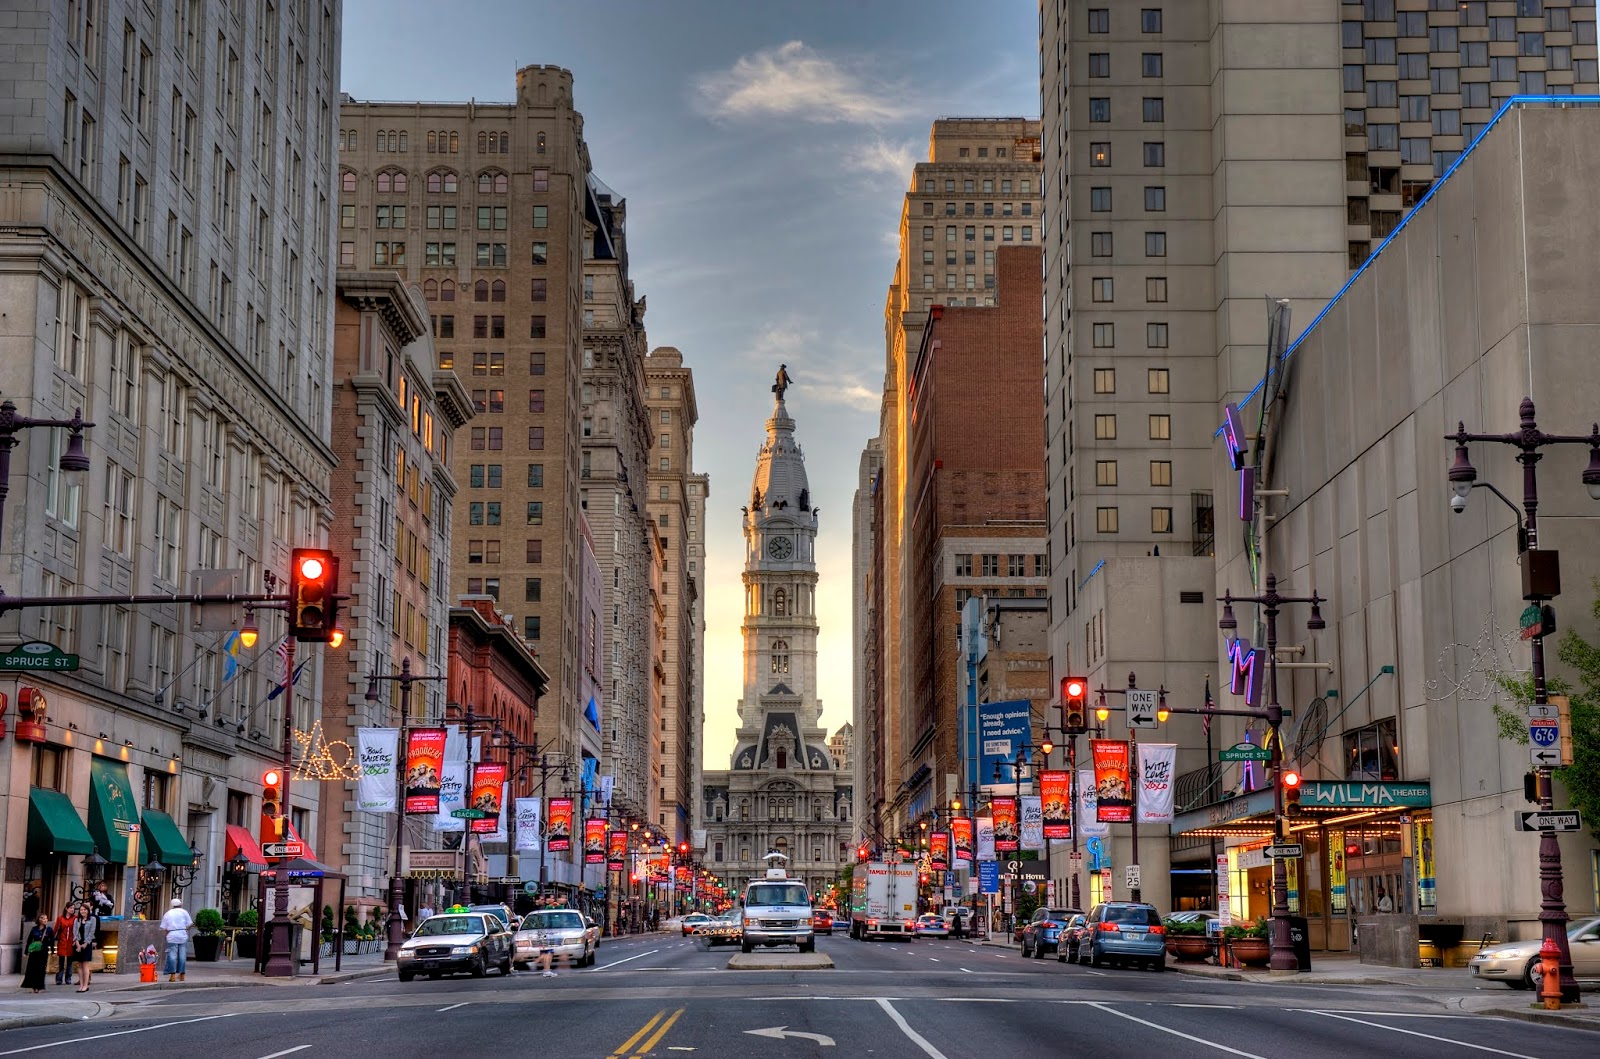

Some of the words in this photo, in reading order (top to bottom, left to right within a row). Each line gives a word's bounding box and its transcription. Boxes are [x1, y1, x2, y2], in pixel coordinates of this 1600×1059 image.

[5, 656, 49, 666] SPRUCE
[54, 658, 70, 666] ST.
[1132, 693, 1152, 702] ONE
[1131, 703, 1153, 712] WAY
[1538, 707, 1548, 715] TO
[1005, 711, 1029, 720] opinions
[1535, 728, 1554, 742] 676
[408, 746, 442, 759] PRODUCERS
[1096, 760, 1128, 771] PRODUCERS
[1145, 759, 1171, 772] WITH
[363, 768, 388, 776] XOXO
[1145, 782, 1168, 790] XOXO
[1042, 786, 1068, 796] PRODUCERS
[1316, 783, 1394, 804] WILMA
[1539, 816, 1555, 825] ONE
[1558, 816, 1574, 824] WAY
[1127, 878, 1139, 886] 25
